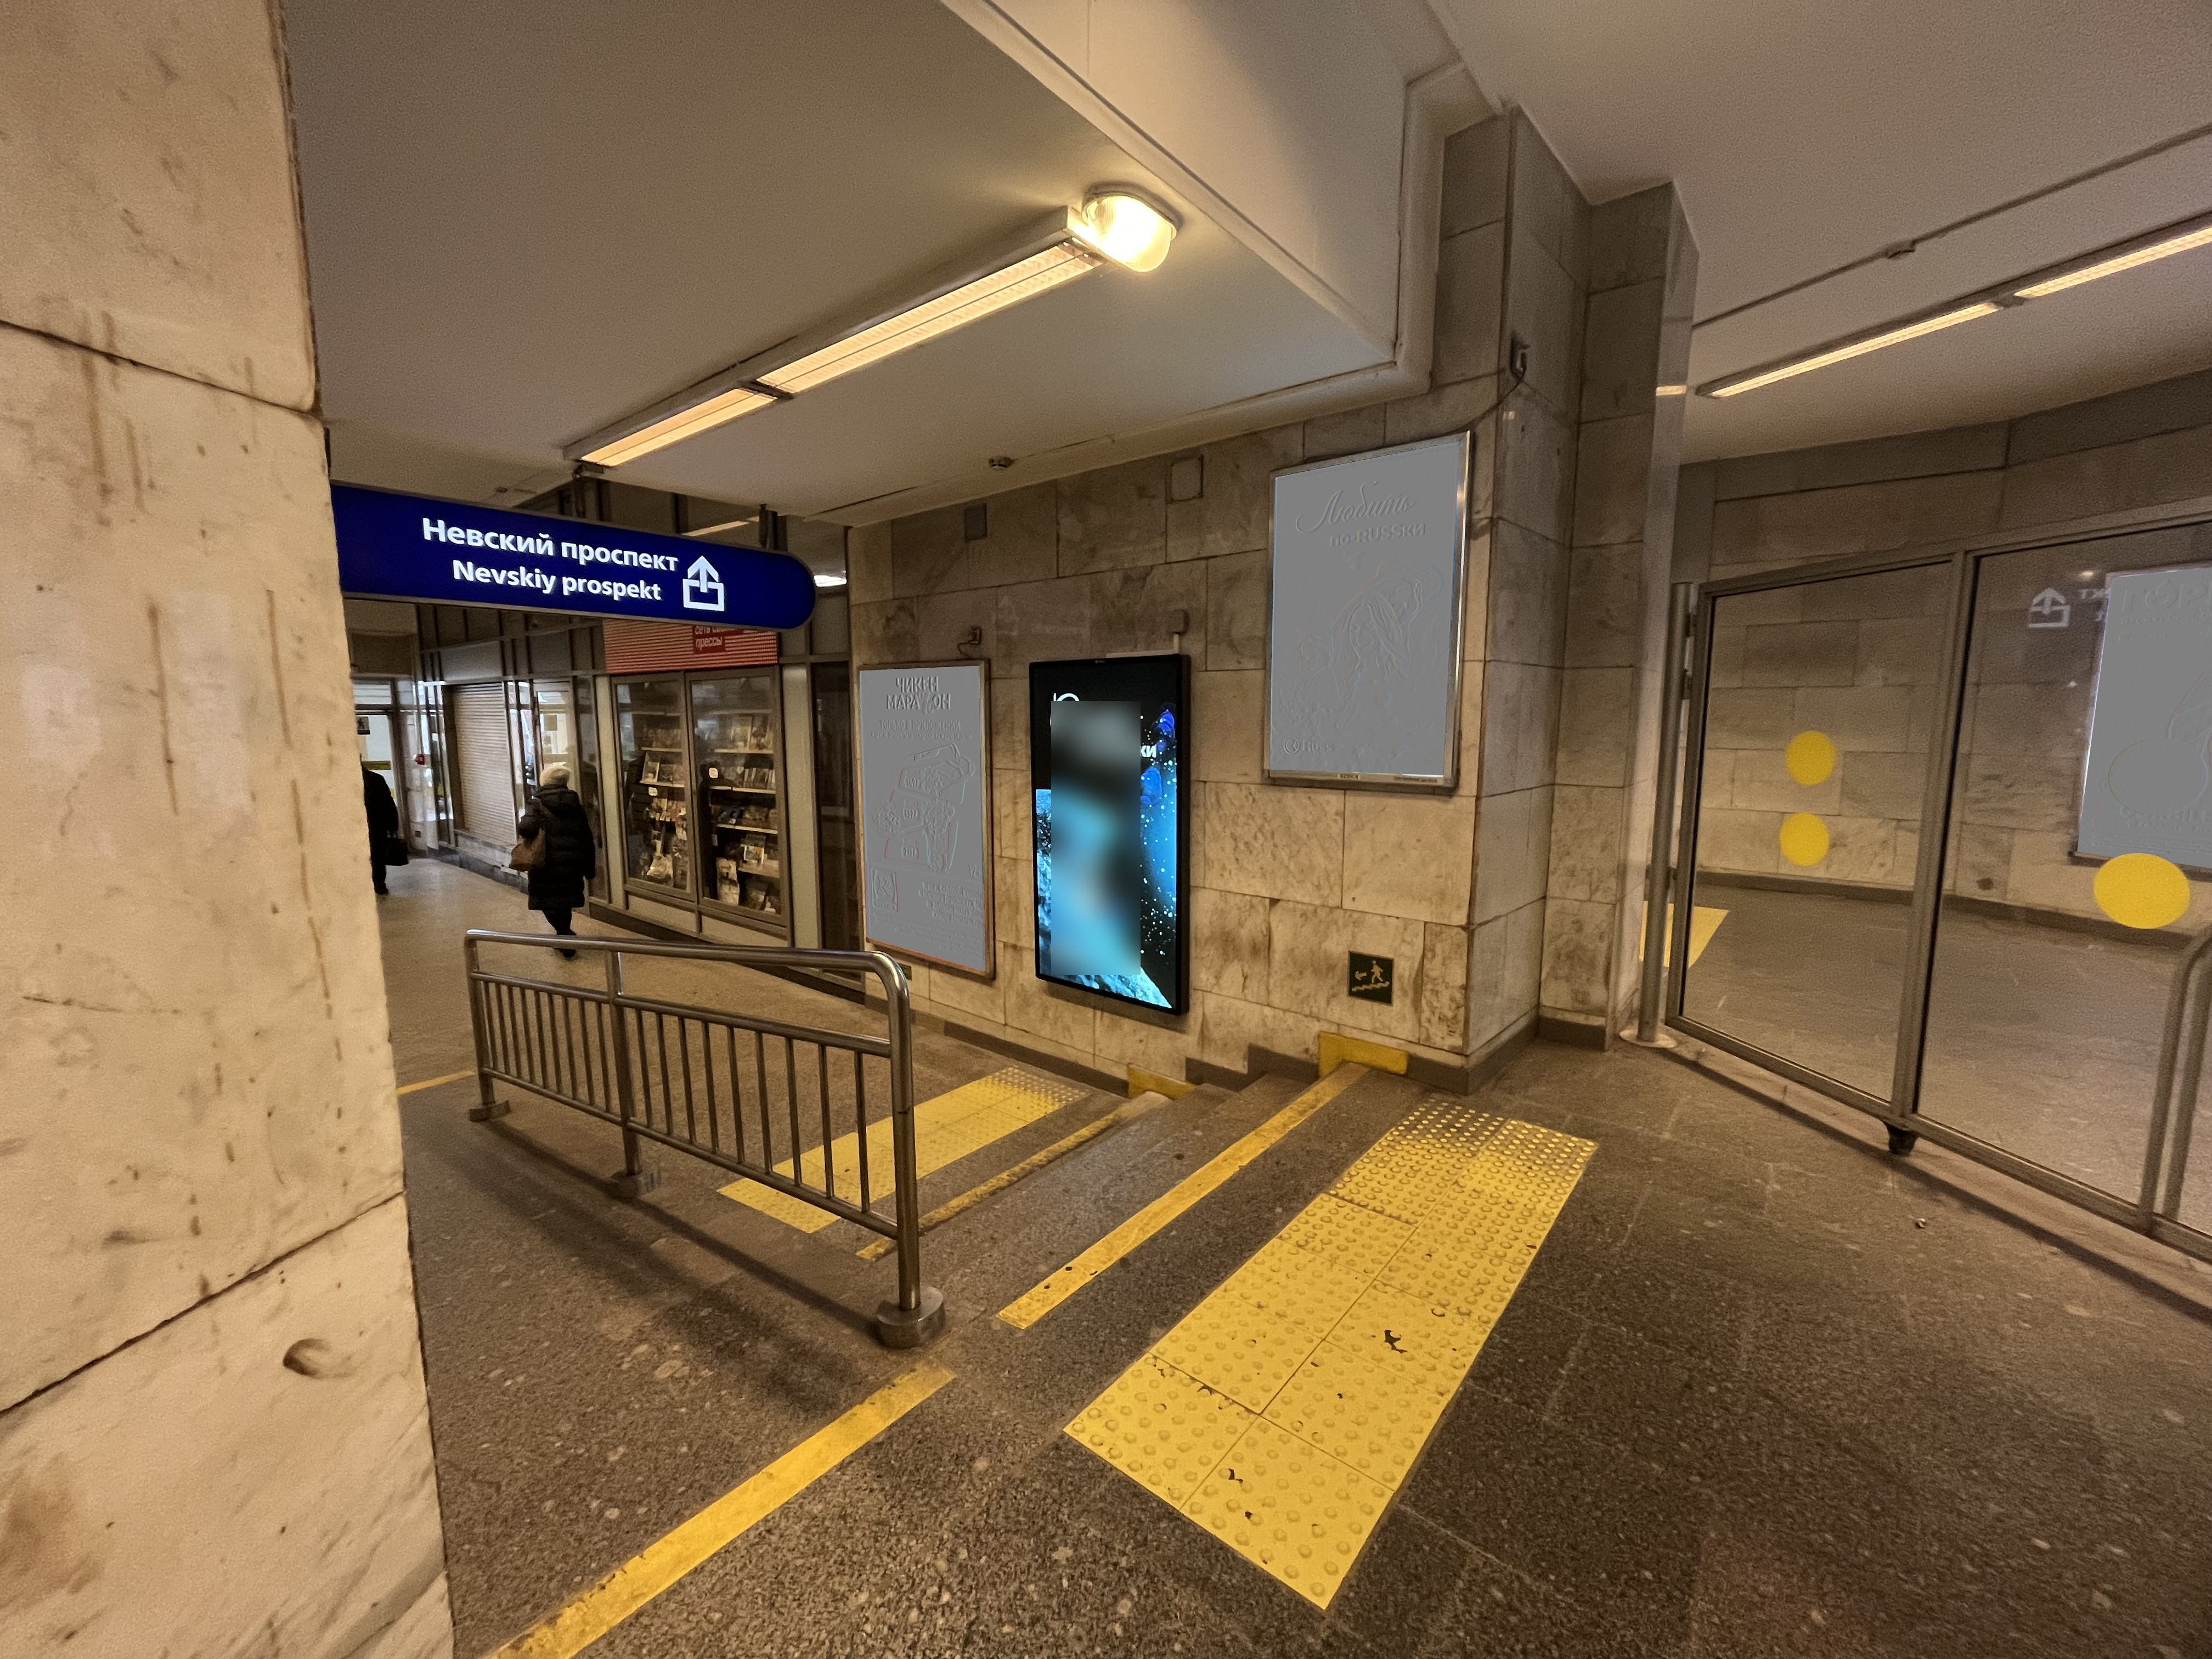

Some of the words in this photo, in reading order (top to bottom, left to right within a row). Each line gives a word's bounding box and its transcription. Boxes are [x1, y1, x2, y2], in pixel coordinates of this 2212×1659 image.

[422, 517, 554, 556] Невский
[561, 541, 679, 572] проспект
[453, 560, 556, 594] Nevskiy
[562, 576, 662, 601] prospekt
[696, 636, 723, 651] прессы
[968, 864, 982, 878] 12+
